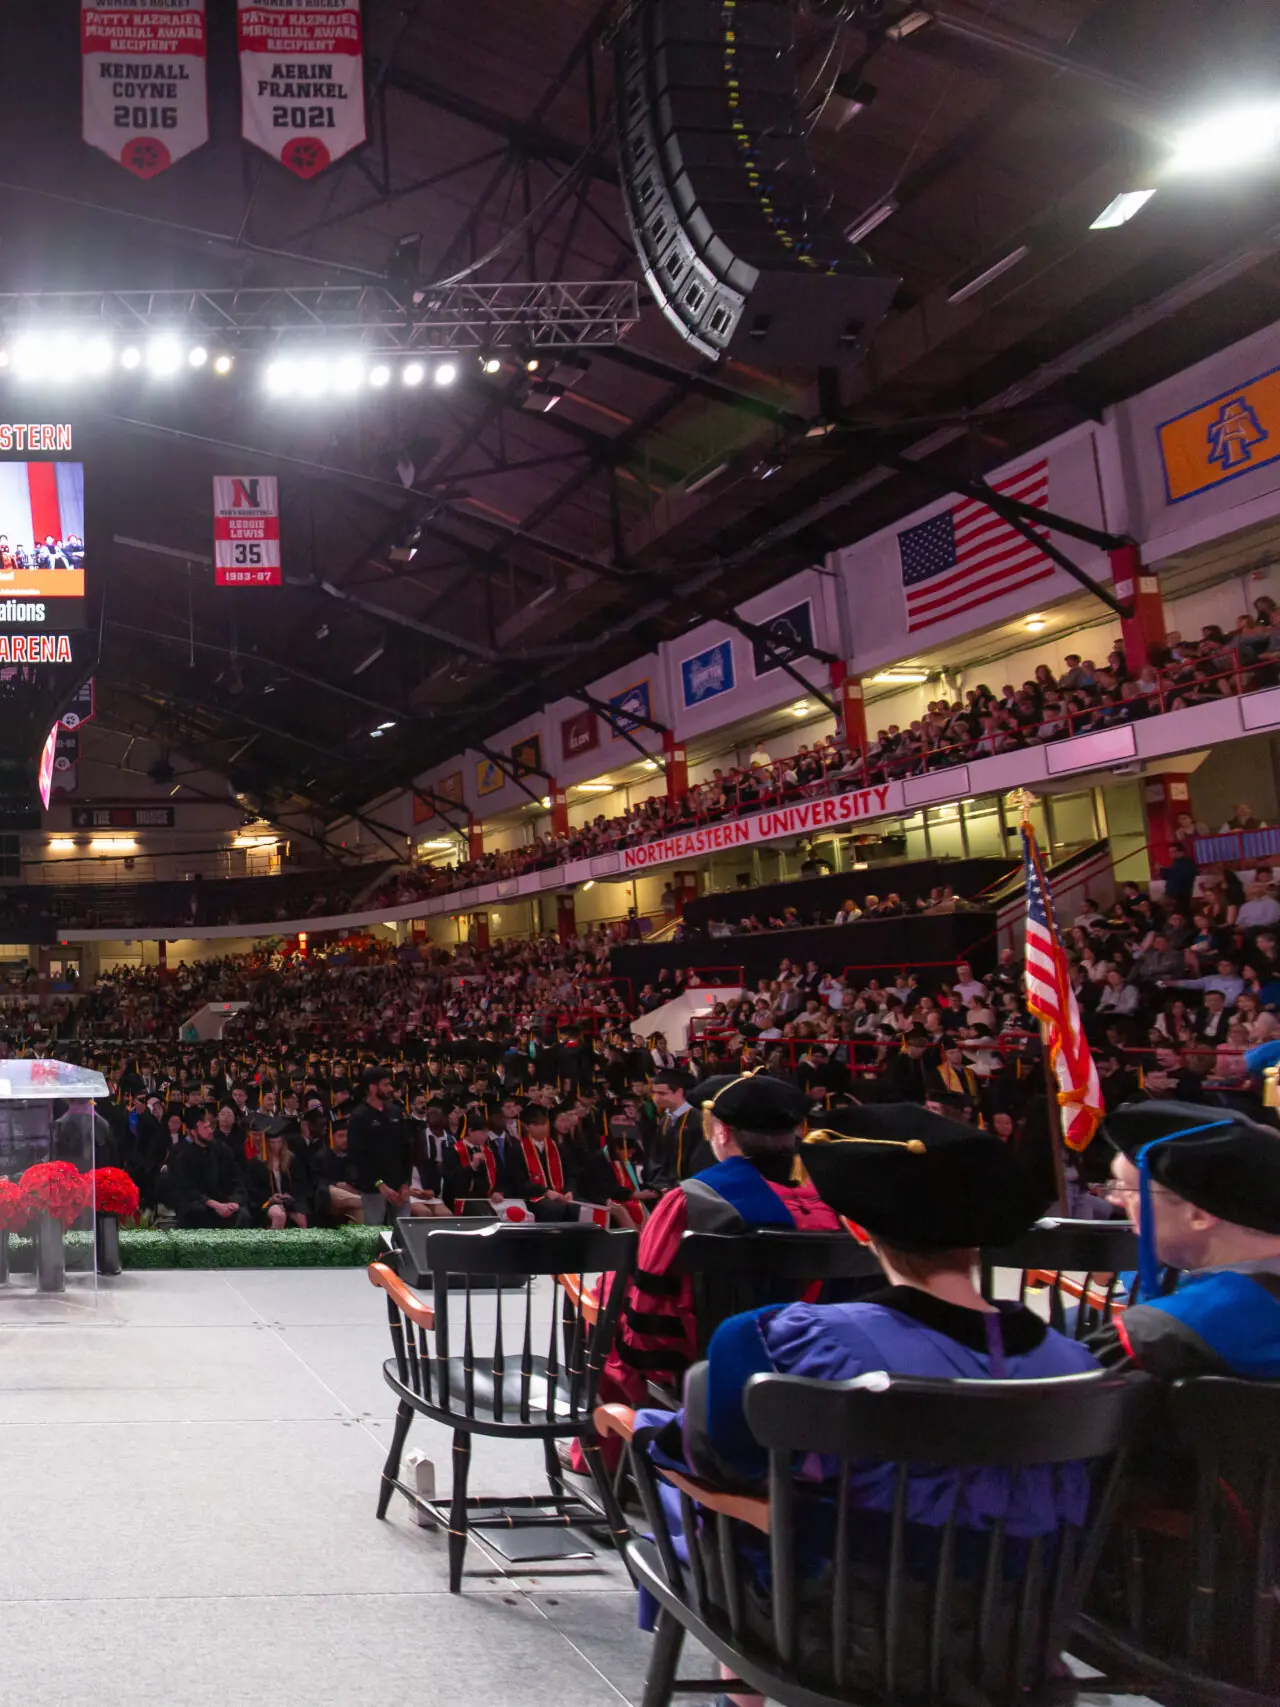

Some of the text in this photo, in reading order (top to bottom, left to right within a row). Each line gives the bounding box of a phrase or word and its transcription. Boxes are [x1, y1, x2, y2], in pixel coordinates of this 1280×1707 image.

[86, 12, 201, 26] PATTY KAZMAIER
[242, 11, 357, 26] PATTY KAZMAIER
[85, 25, 203, 39] MEMORIAL AWARD
[242, 25, 358, 40] MEMORIAL AWARD
[110, 39, 179, 51] RECIPIENT
[267, 38, 336, 51] RECIPIENT
[99, 62, 190, 80] KENDALL
[271, 64, 333, 80] AERIN
[112, 81, 177, 100] COYNE
[257, 81, 348, 100] FRANKEL
[113, 105, 178, 129] 2016
[272, 106, 336, 129] 2021
[231, 478, 260, 508] N
[229, 519, 265, 529] REGGIE
[230, 529, 265, 538] LEWIS
[235, 543, 261, 563] 35
[93, 810, 111, 826] THE
[624, 785, 890, 868] NORTHEASTERN UNIVERSITY
